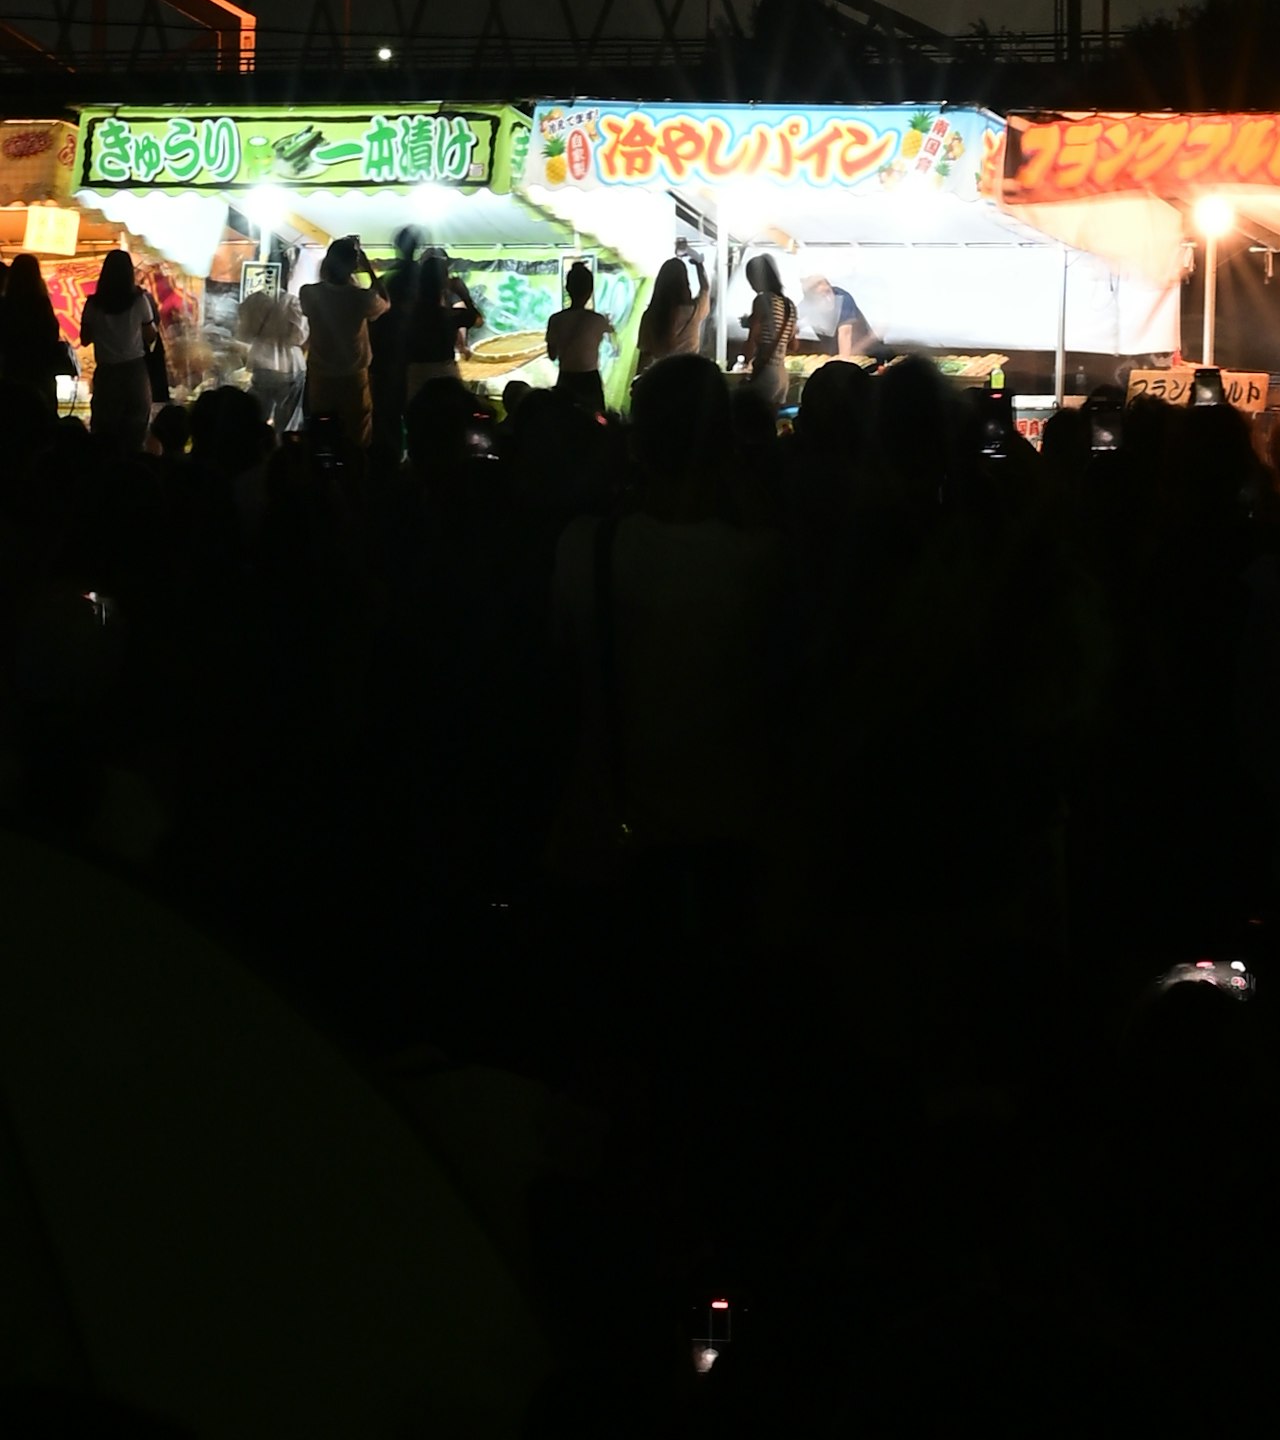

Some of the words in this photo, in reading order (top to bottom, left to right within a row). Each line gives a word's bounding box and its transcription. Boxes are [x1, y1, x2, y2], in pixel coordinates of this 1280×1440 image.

[98, 118, 239, 181] きゅうり
[311, 117, 477, 180] 一本漬け
[602, 116, 891, 178] 冷やしパイン
[1126, 380, 1260, 408] フランルト
